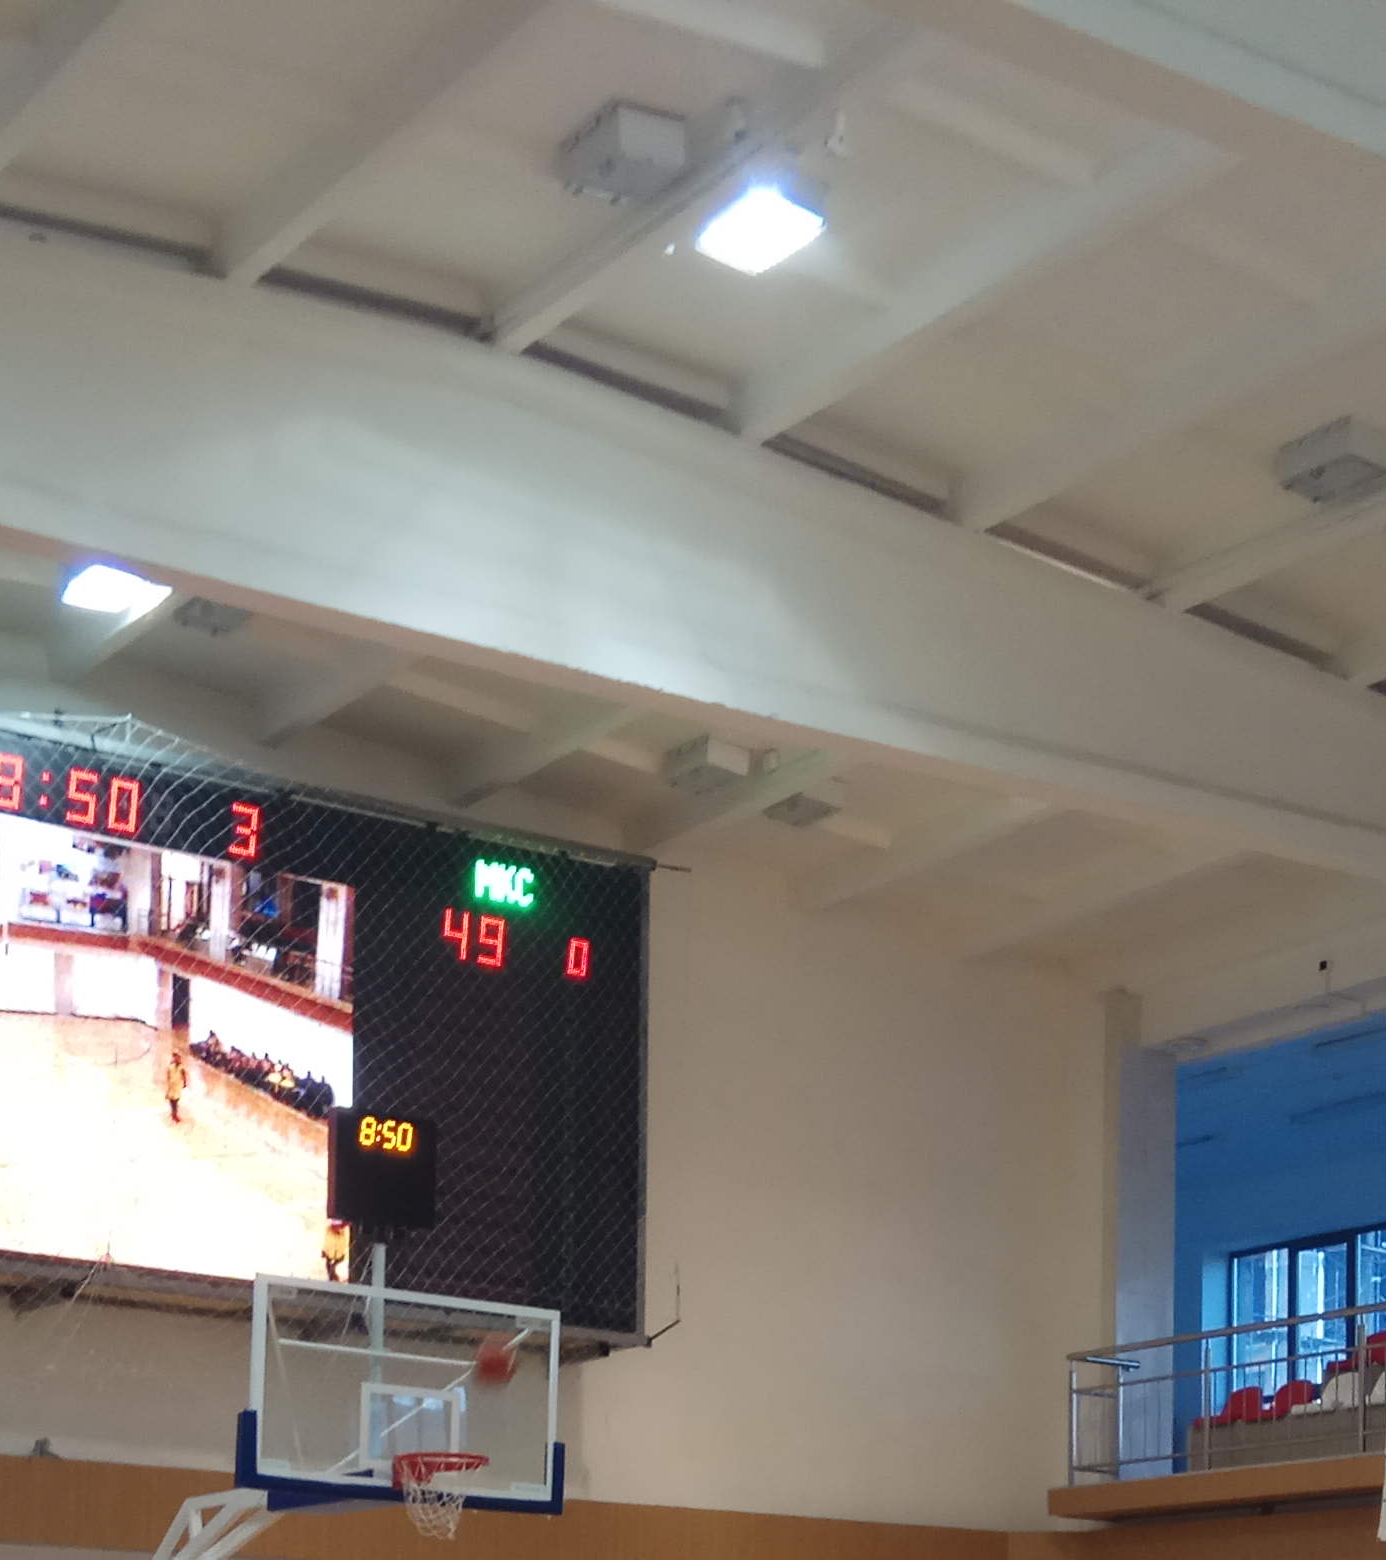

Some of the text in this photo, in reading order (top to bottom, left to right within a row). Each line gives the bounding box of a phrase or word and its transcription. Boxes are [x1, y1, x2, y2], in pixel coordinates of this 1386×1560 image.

[228, 801, 261, 858] 3
[442, 907, 506, 968] 49
[566, 936, 590, 978] 0
[358, 1116, 414, 1152] 8:50
